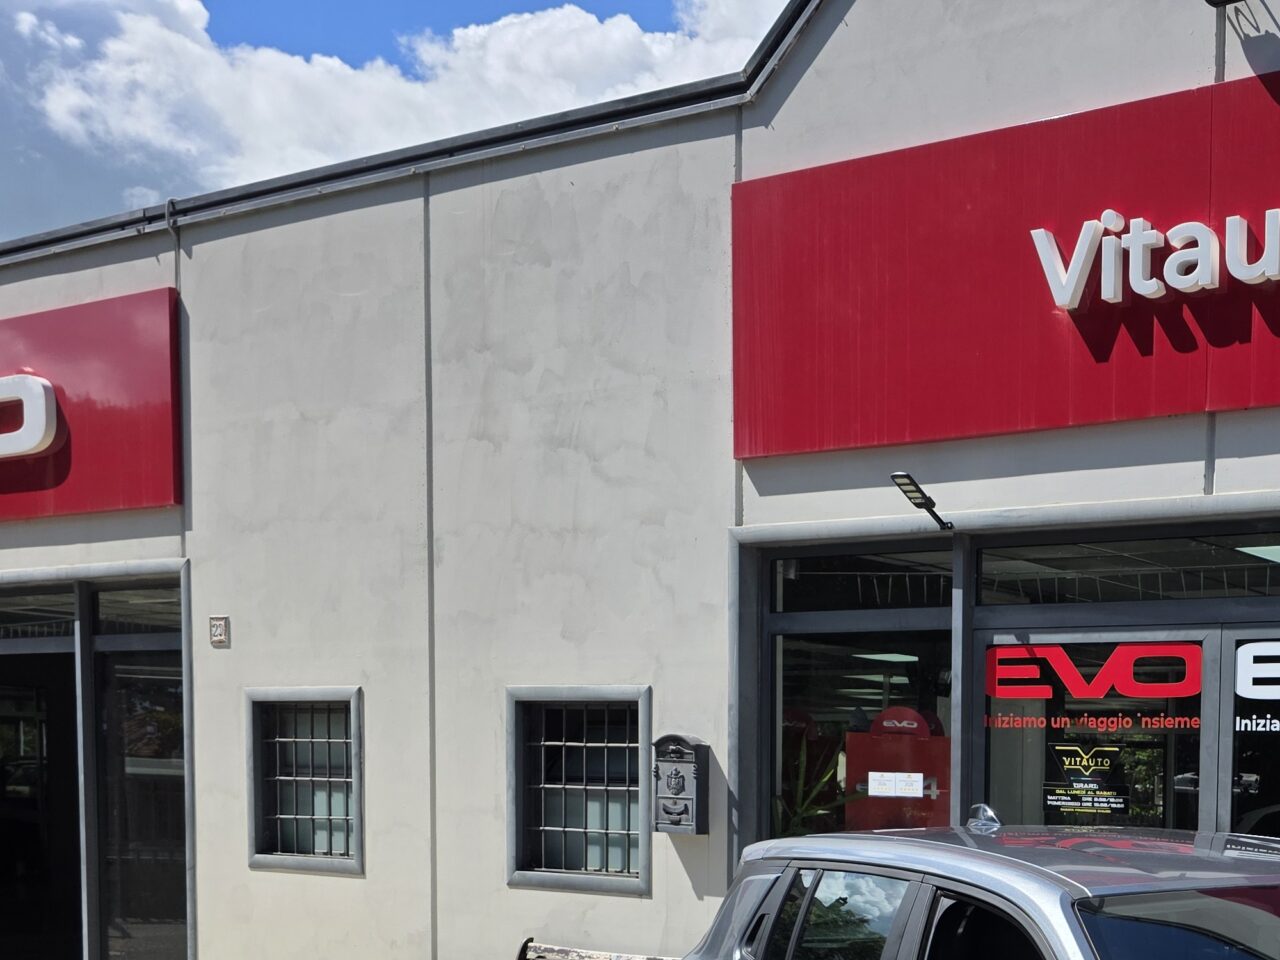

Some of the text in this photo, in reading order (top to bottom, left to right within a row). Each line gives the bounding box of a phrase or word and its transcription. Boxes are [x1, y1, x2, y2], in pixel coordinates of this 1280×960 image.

[986, 643, 1203, 699] EVO
[1051, 716, 1071, 729] un
[1075, 713, 1133, 732] viaggio
[1137, 712, 1200, 729] nsieme
[1062, 756, 1111, 767] VITAUTO
